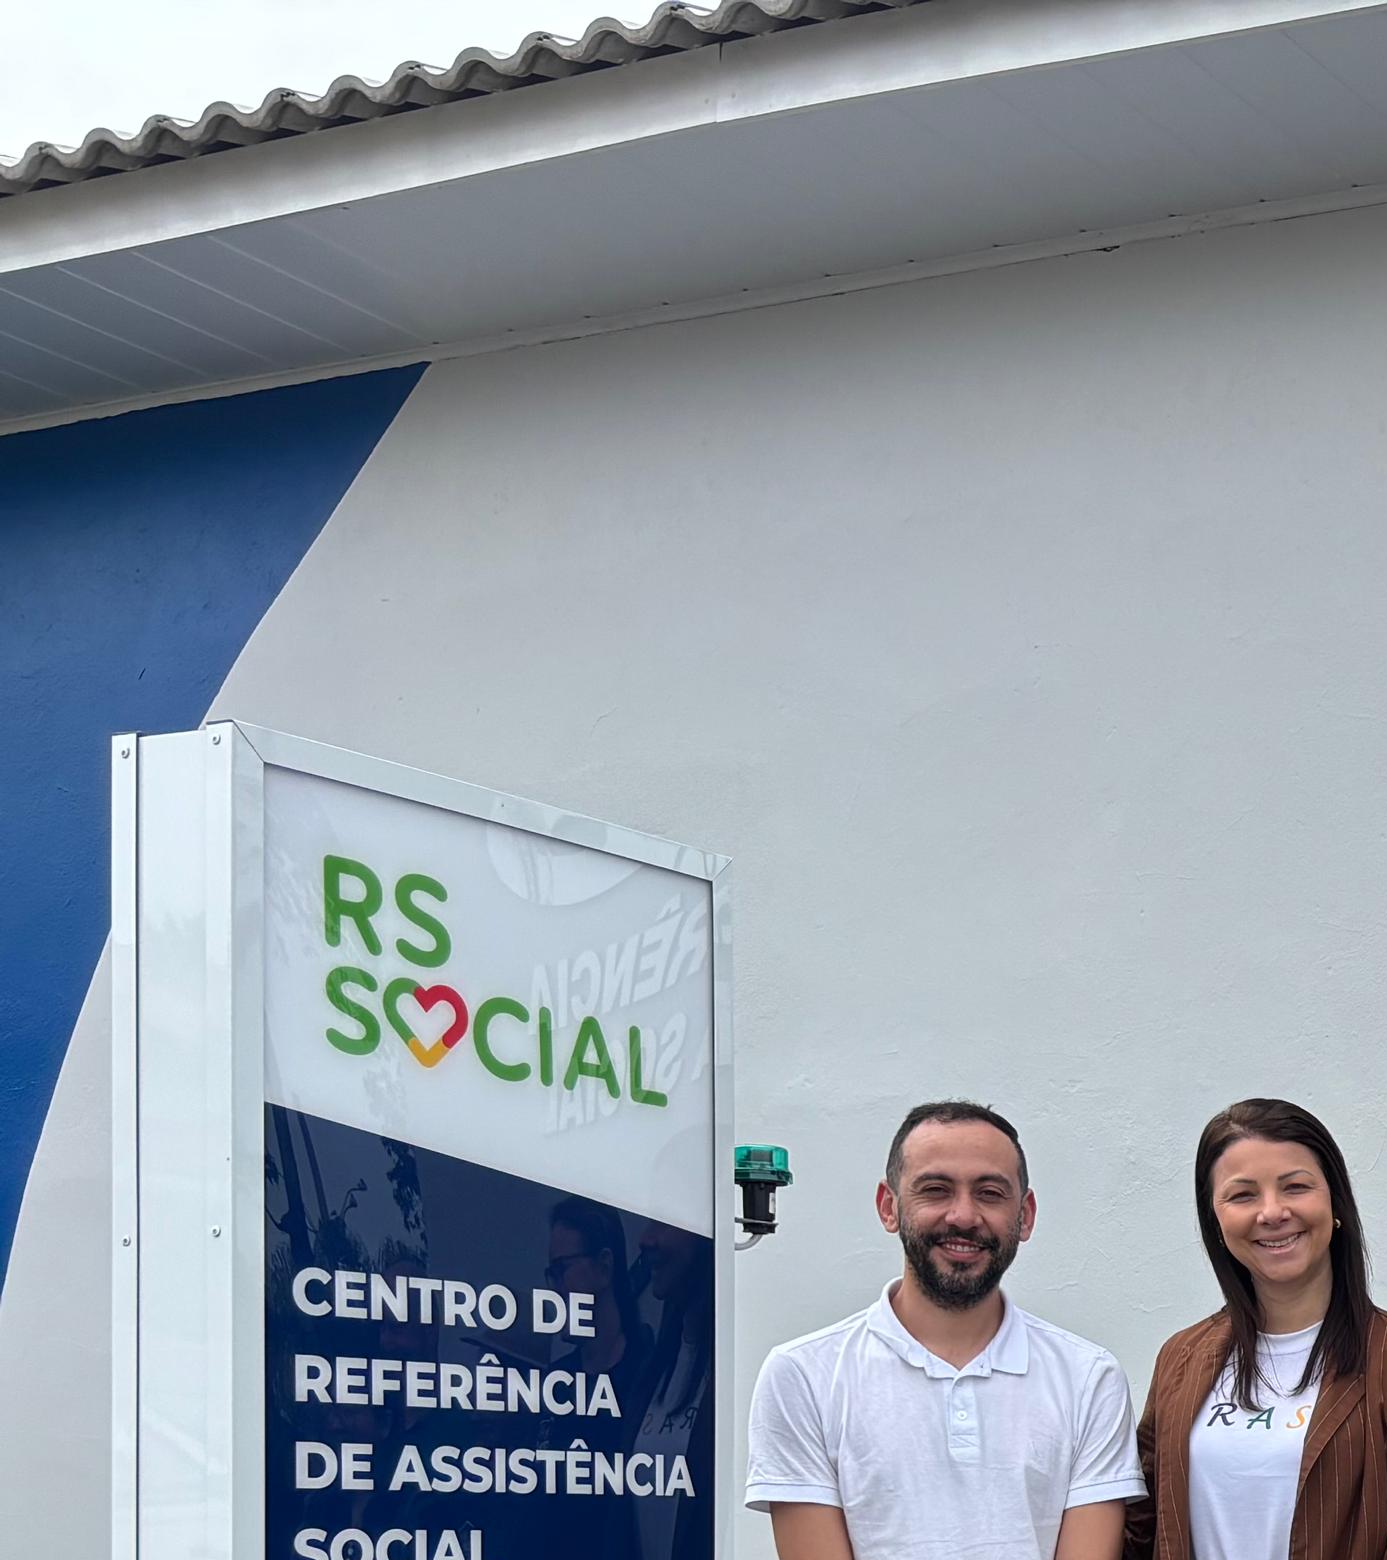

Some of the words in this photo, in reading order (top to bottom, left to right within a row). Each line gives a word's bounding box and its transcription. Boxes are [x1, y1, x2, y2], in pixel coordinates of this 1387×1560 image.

[323, 854, 451, 967] RS
[325, 966, 668, 1108] SOCIAL
[292, 1266, 517, 1331] CENTRO
[532, 1288, 596, 1338] DE
[294, 1353, 622, 1418] REFERÊNCIA
[294, 1441, 374, 1491] DE
[388, 1438, 696, 1498] ASSISTÊNCIA
